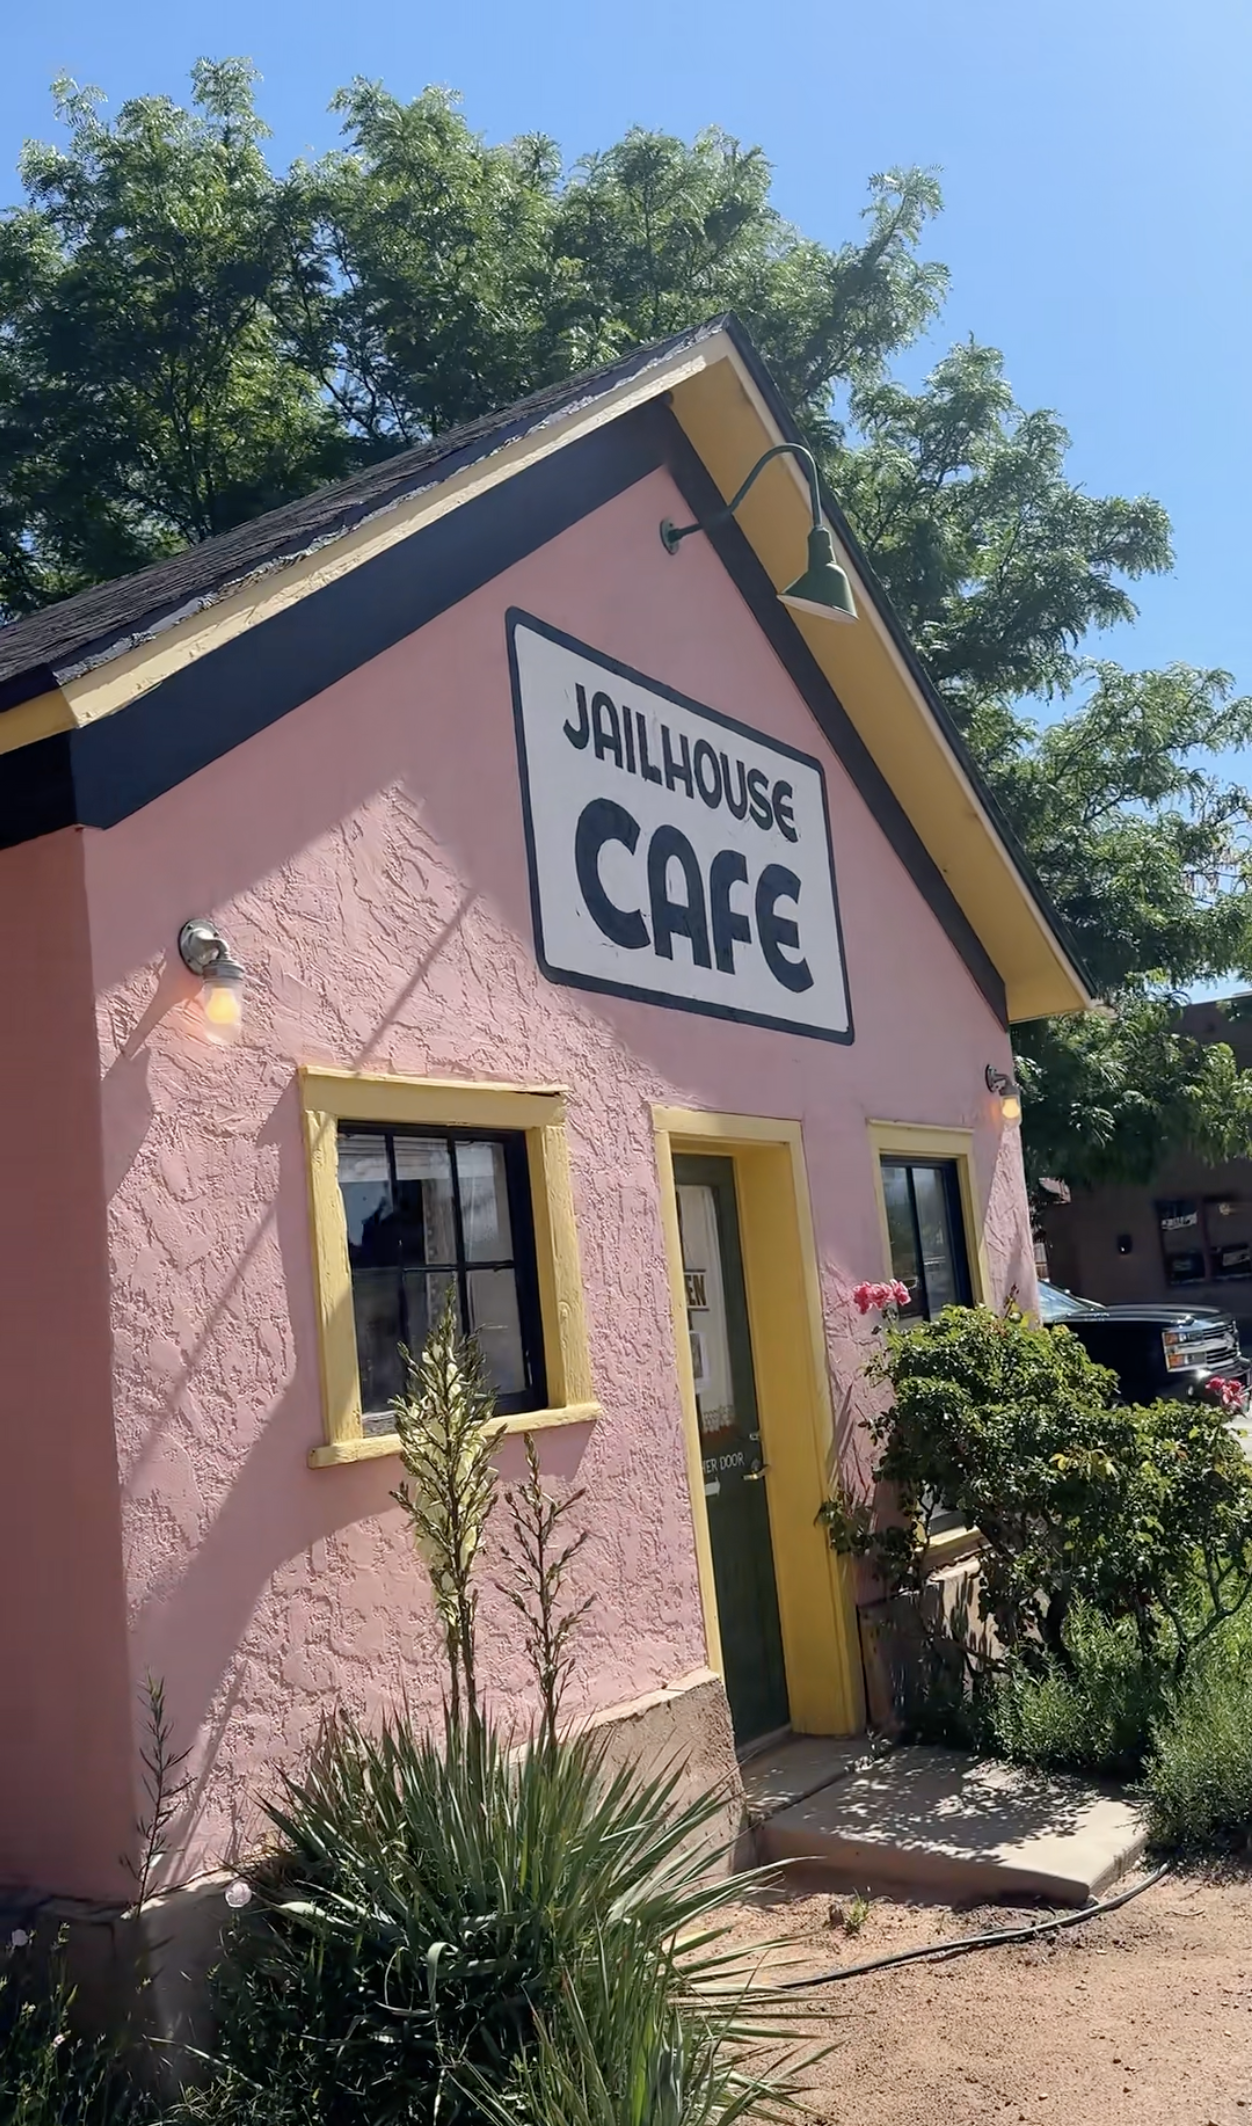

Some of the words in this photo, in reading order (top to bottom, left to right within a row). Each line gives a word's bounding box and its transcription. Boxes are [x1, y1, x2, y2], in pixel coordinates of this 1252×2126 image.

[563, 683, 798, 843] JAILHOUSE
[575, 798, 814, 993] CAFE
[720, 1452, 745, 1470] DOOR
